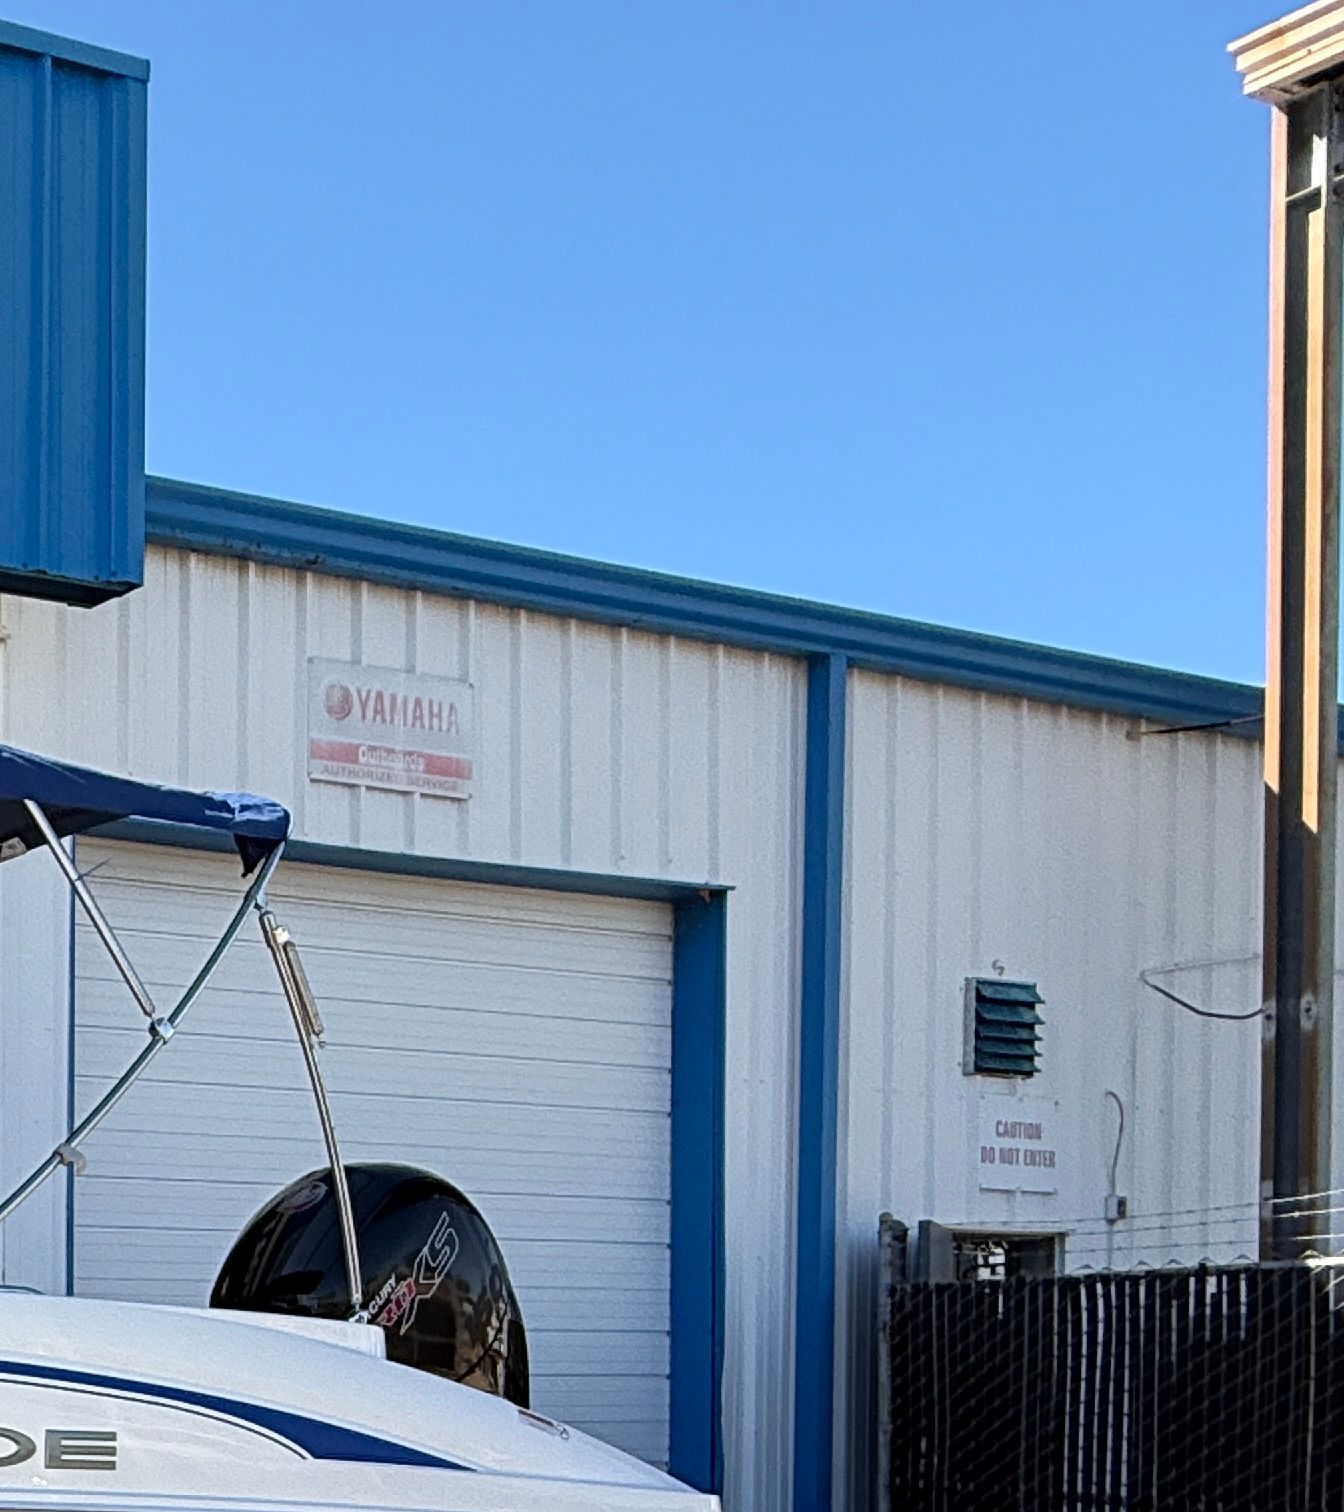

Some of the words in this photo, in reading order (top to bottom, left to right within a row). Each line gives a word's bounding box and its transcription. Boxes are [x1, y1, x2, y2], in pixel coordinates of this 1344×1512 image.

[356, 687, 460, 735] YAMAHA
[320, 764, 404, 786] AUTHORIZE
[995, 1119, 1042, 1140] CAUTION
[980, 1145, 996, 1164] DO
[998, 1147, 1020, 1166] NOT
[1023, 1148, 1056, 1168] ENTER
